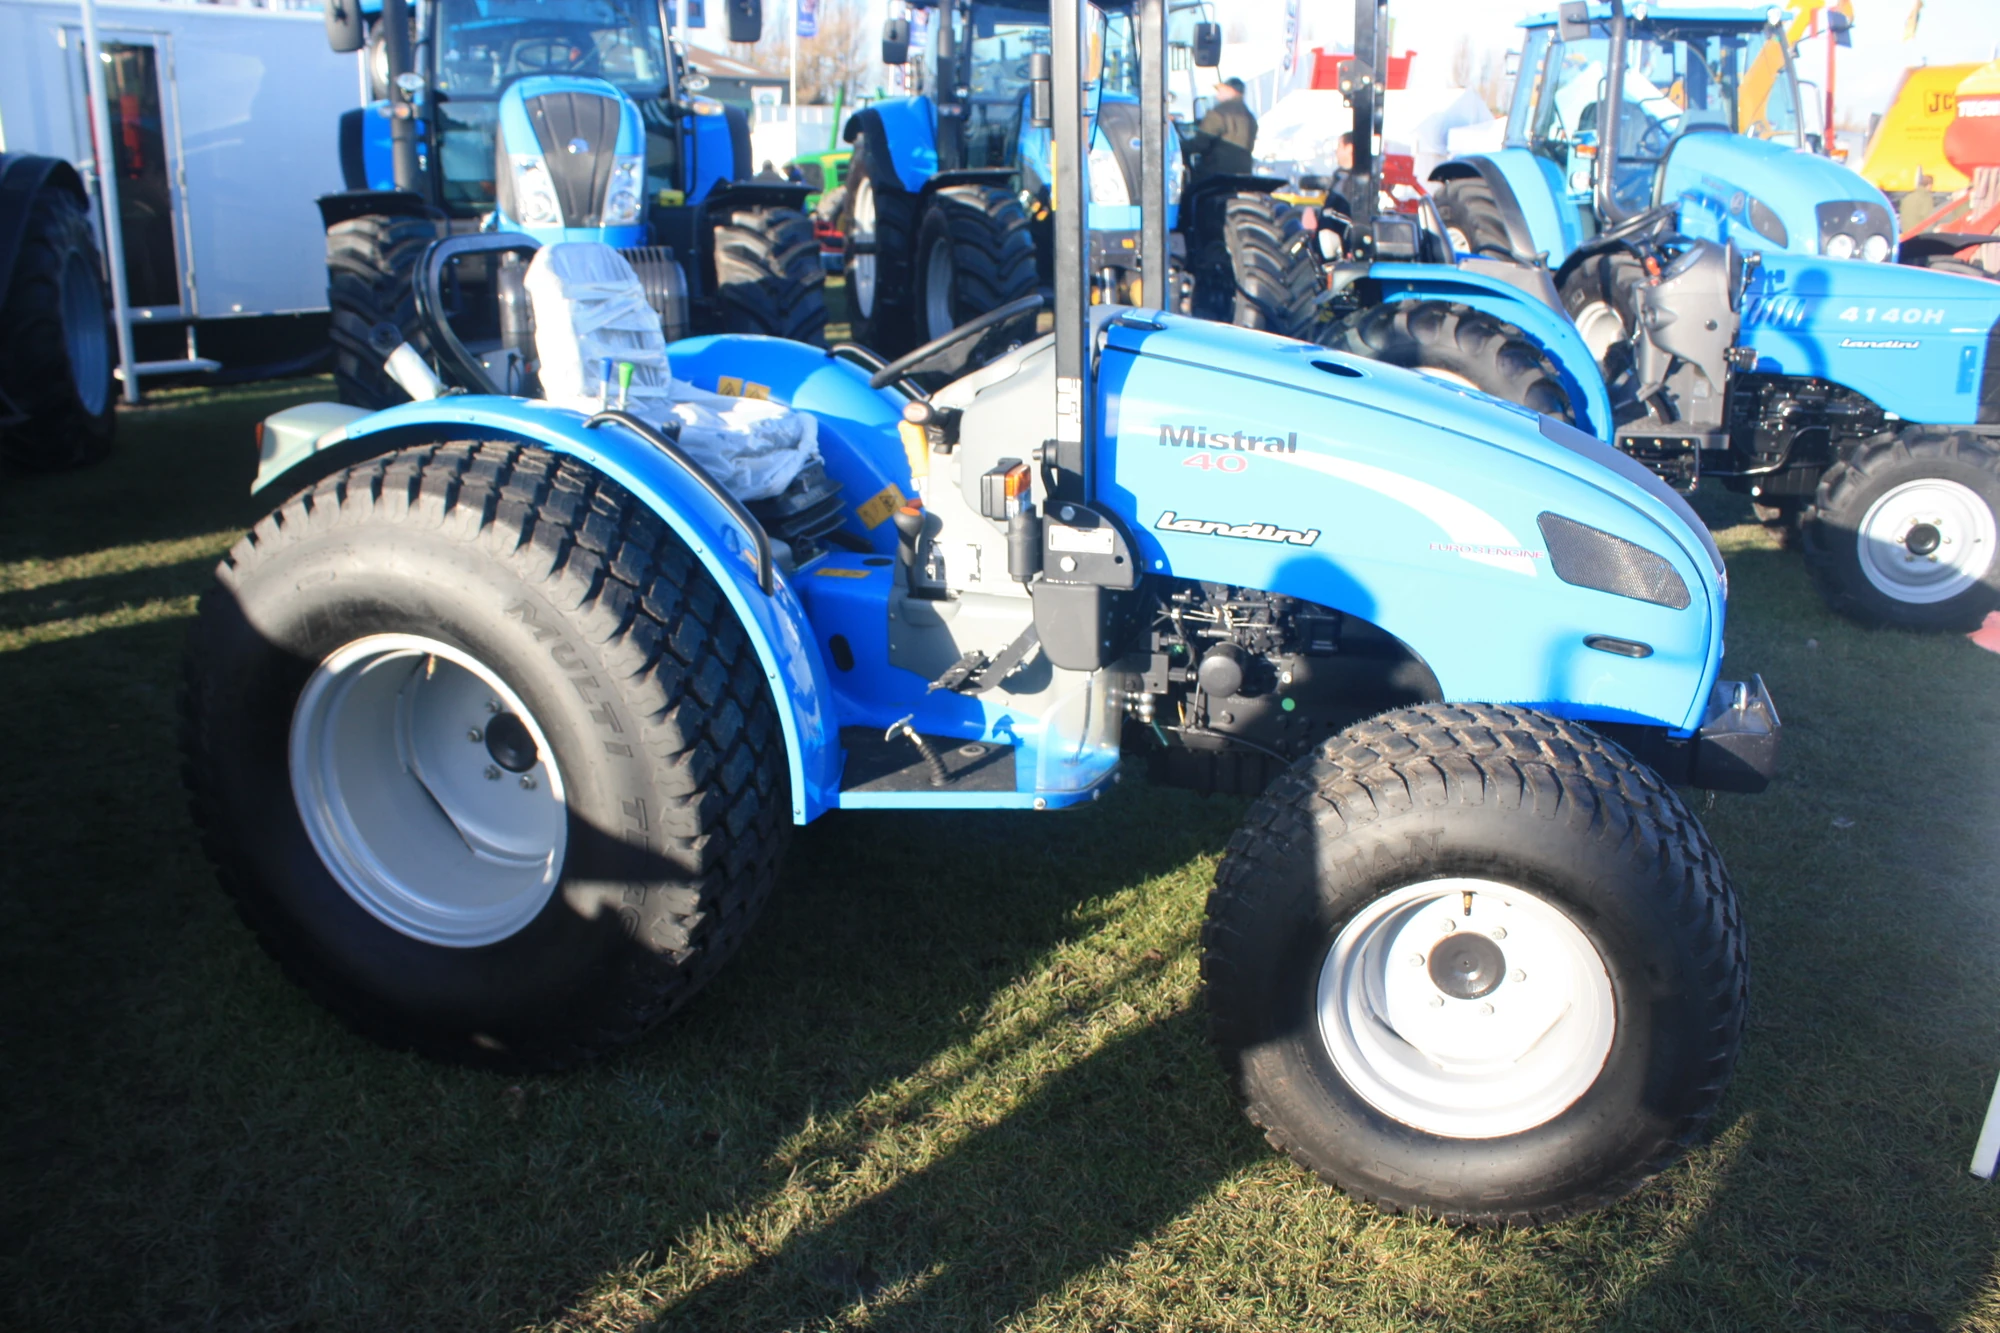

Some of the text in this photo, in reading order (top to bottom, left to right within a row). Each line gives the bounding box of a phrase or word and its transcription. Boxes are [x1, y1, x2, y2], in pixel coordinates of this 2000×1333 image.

[1929, 93, 1954, 112] JC
[1839, 306, 1946, 325] 4140H
[1159, 424, 1298, 454] Mistral
[1182, 453, 1249, 474] 40
[1154, 510, 1322, 547] Landini
[1428, 543, 1472, 554] EURO
[1487, 547, 1545, 559] ENGINE
[504, 599, 633, 759] MULTI
[1323, 827, 1446, 906] ITAN
